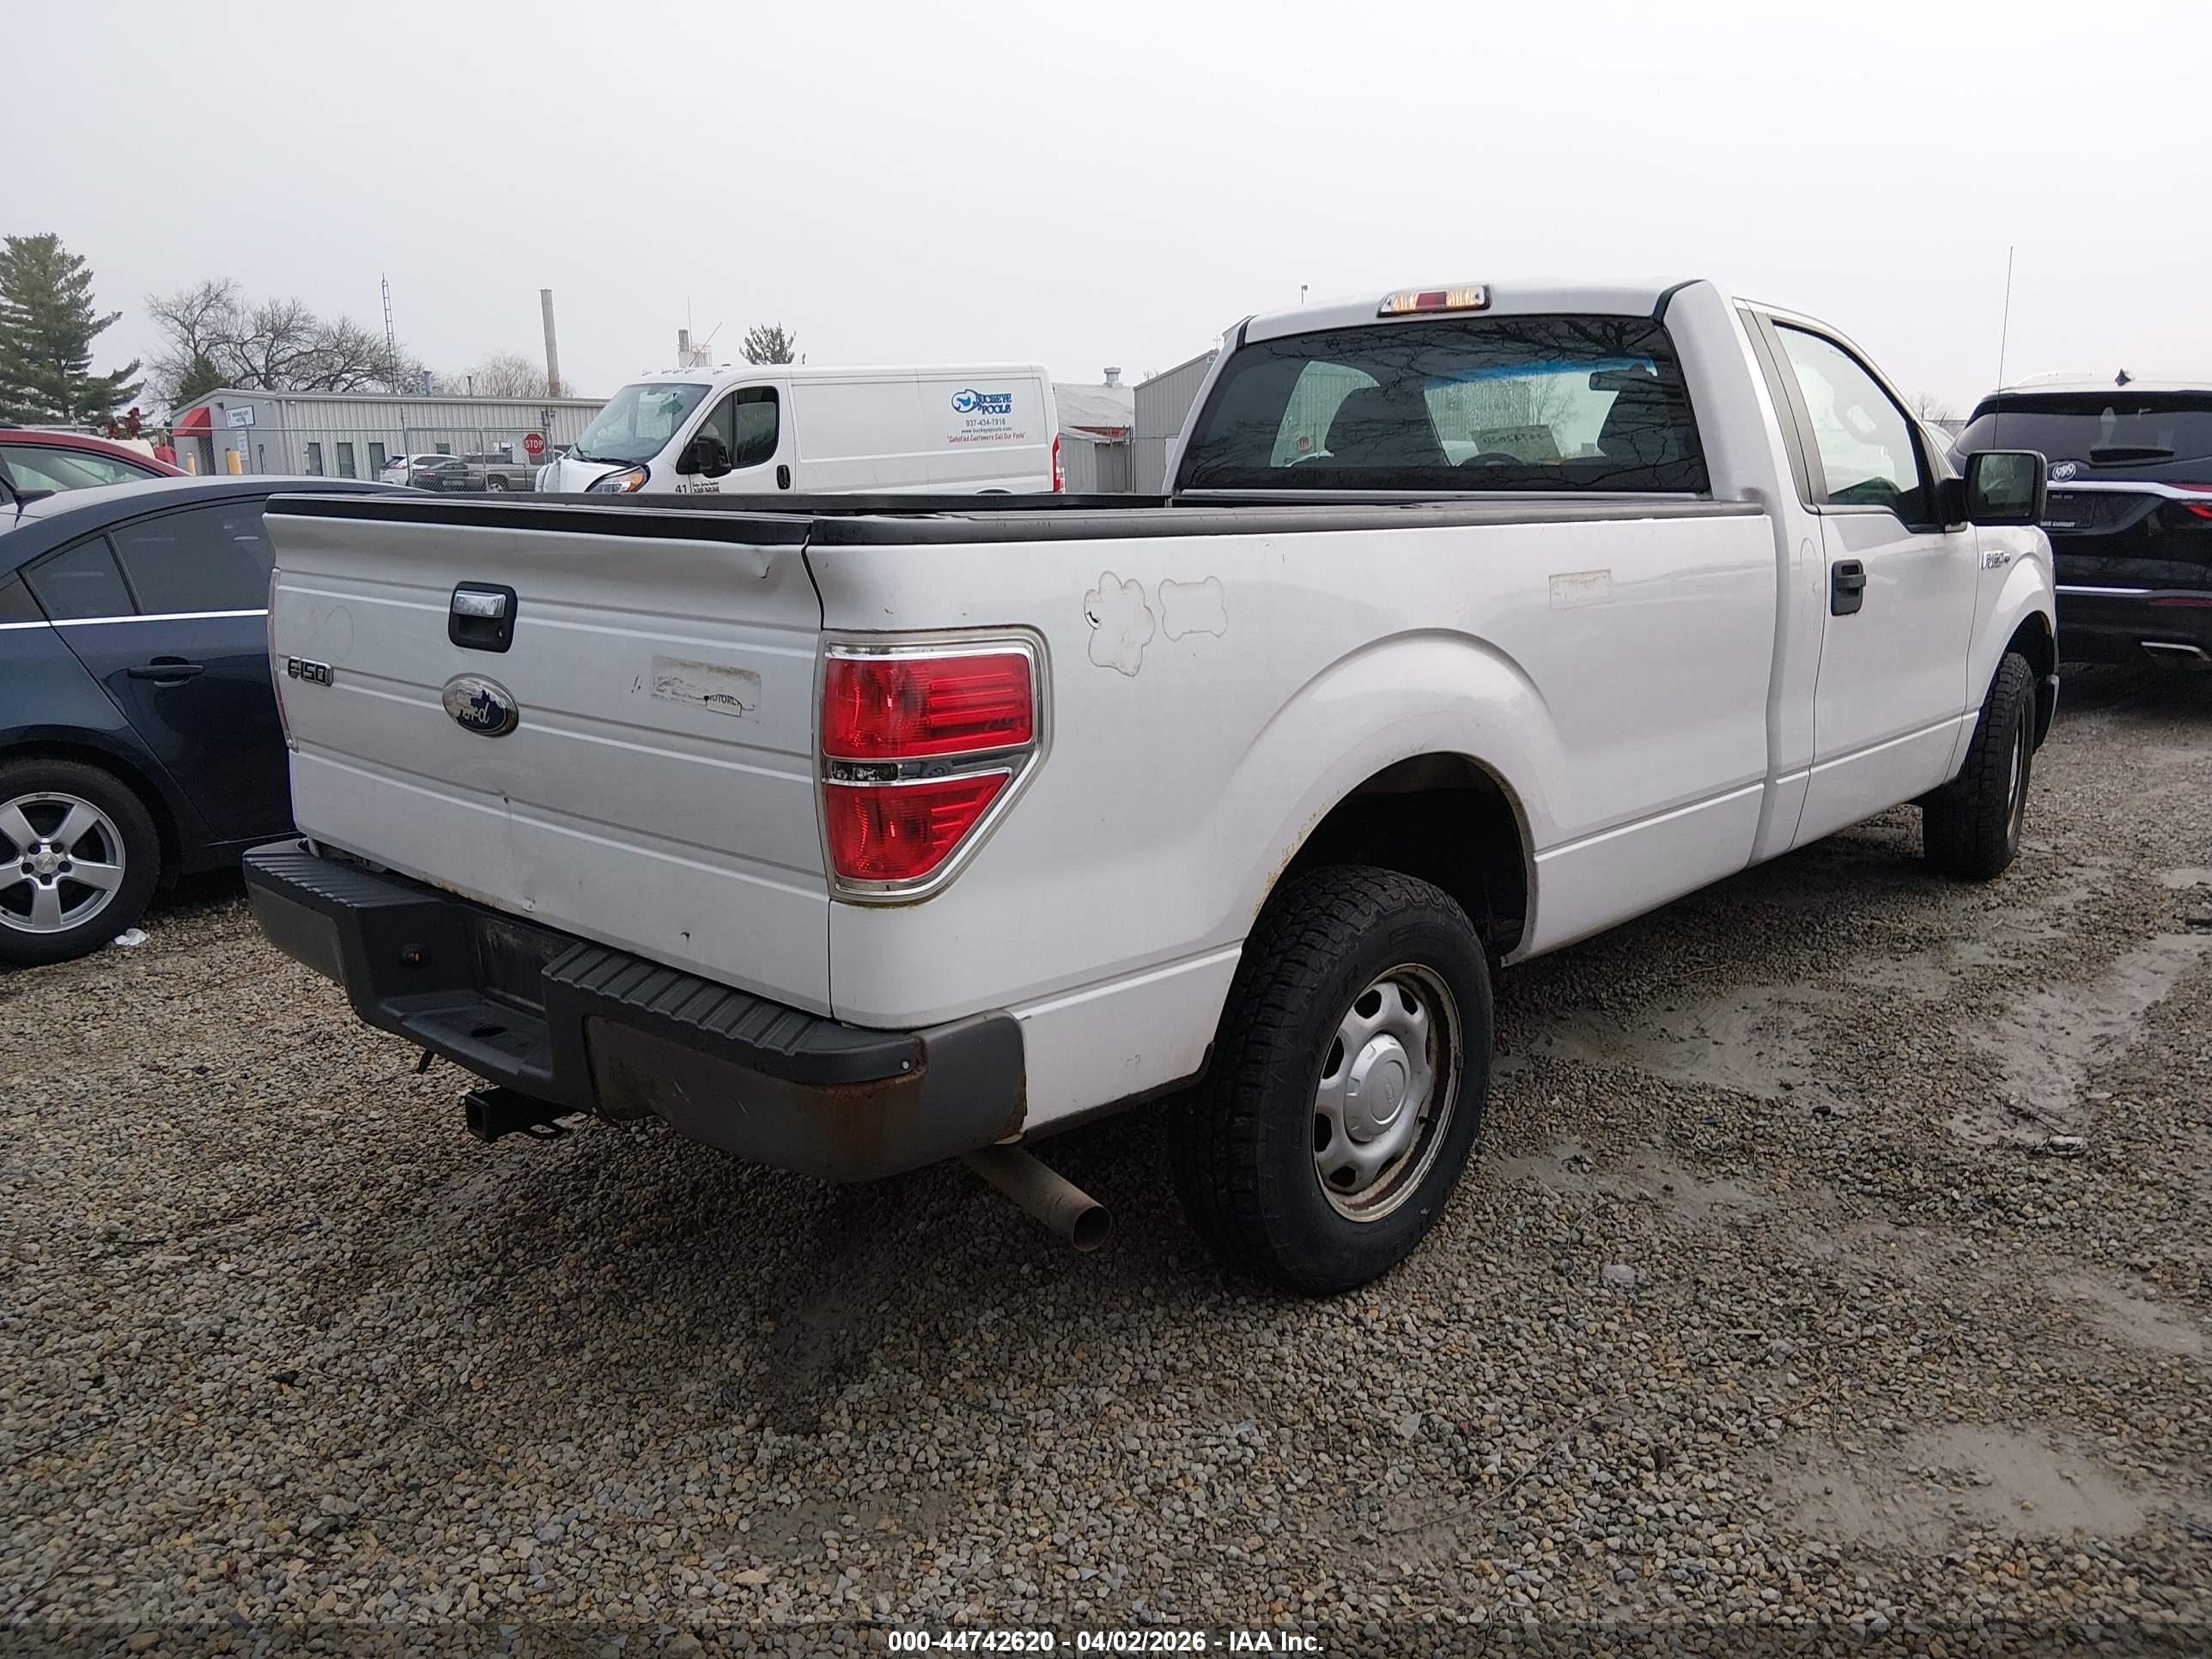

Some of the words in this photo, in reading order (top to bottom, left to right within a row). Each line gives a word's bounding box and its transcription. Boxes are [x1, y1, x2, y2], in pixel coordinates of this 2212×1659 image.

[981, 404, 1012, 415] POOLS
[525, 439, 544, 448] STOP
[675, 483, 687, 494] 41
